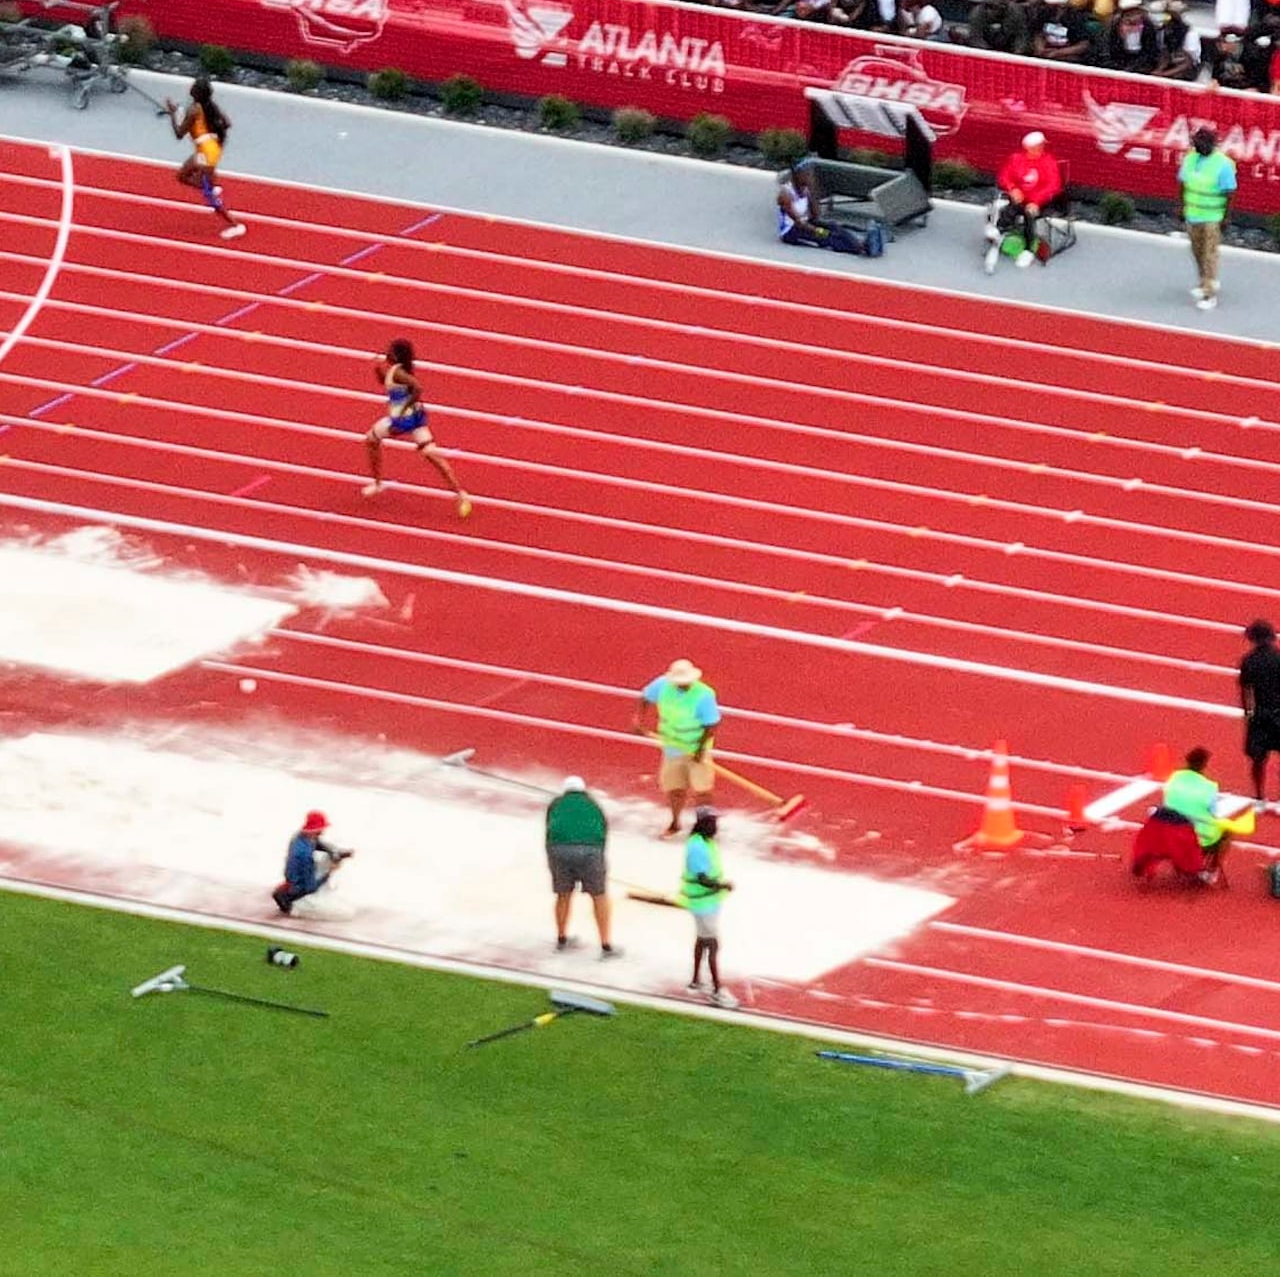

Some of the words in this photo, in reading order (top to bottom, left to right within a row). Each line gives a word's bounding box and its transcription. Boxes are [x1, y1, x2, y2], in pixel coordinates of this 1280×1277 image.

[578, 21, 725, 73] ATLANTA
[578, 54, 652, 80] TRACK
[666, 68, 724, 92] CLUB
